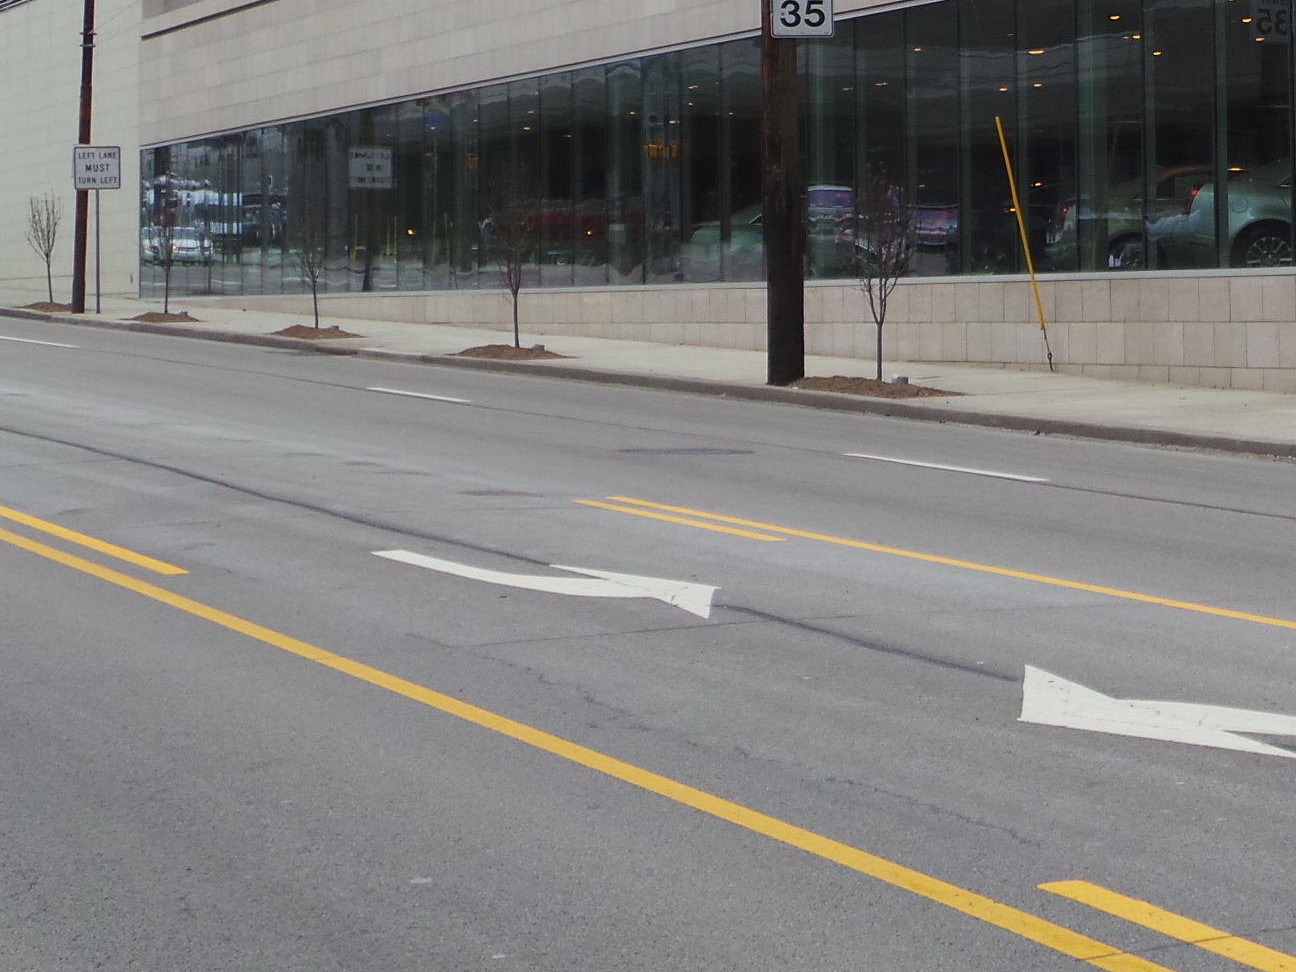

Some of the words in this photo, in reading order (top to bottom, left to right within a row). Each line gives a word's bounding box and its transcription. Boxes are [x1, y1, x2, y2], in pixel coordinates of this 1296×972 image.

[780, 0, 826, 28] 35
[85, 163, 110, 172] MUST
[100, 176, 117, 184] LEFT
